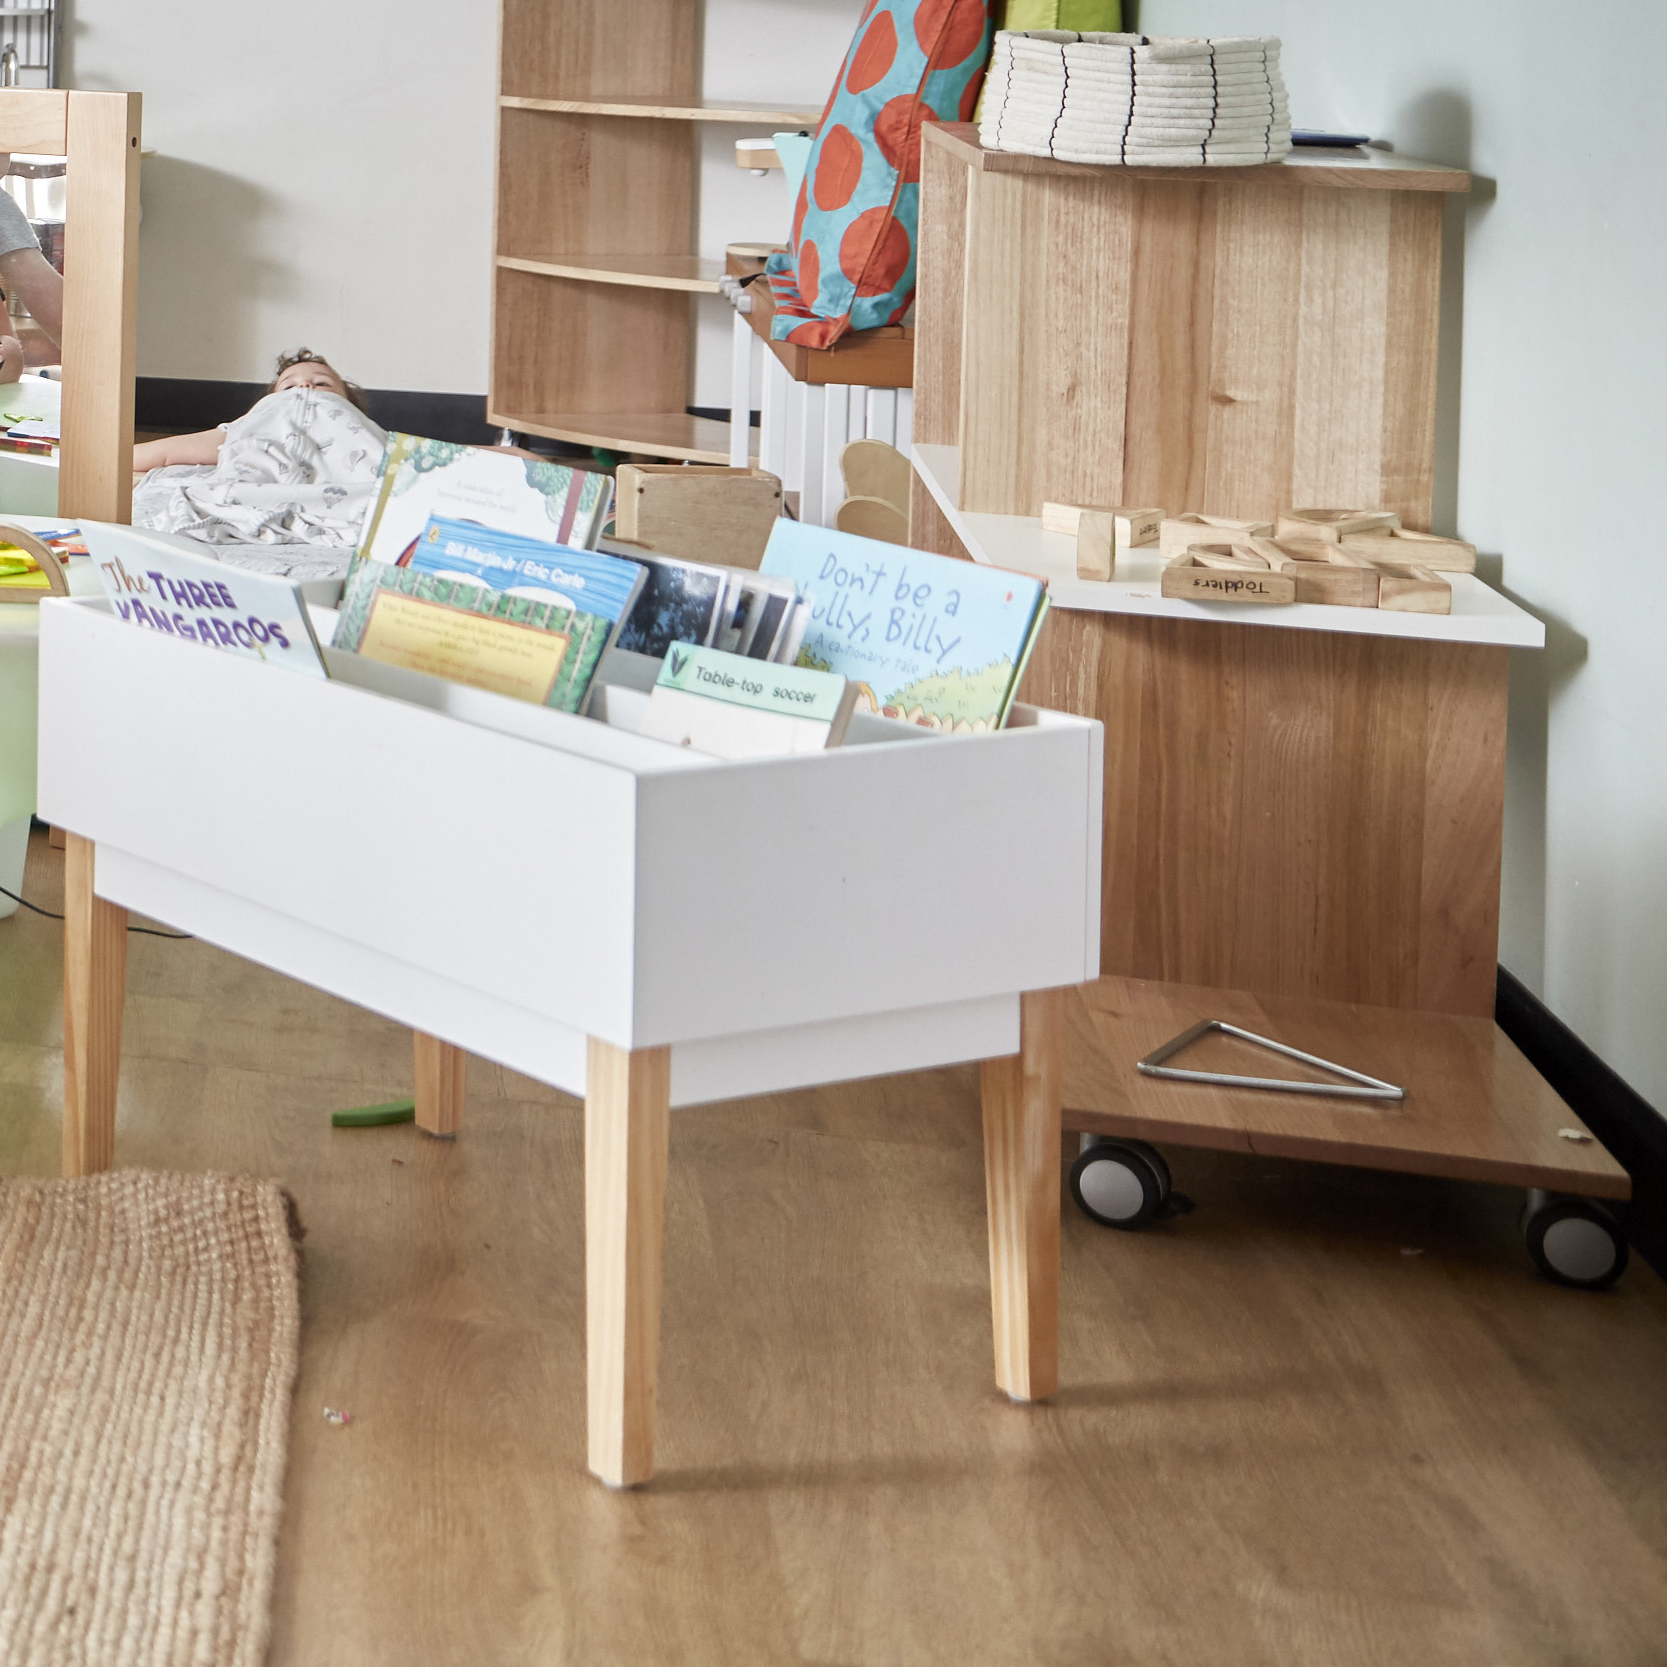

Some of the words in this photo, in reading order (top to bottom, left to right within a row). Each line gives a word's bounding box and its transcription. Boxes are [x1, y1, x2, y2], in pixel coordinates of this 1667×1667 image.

[101, 555, 151, 595] The
[146, 570, 237, 610] THREE
[818, 552, 887, 596] Don't
[894, 565, 932, 608] be
[944, 589, 961, 617] a
[1192, 577, 1270, 596] Toddlers
[802, 581, 872, 642] ully,
[885, 607, 962, 665] Billy
[814, 632, 824, 648] A
[828, 640, 890, 668] cautionary
[894, 658, 920, 675] tale
[696, 666, 764, 695] Table-top
[772, 686, 817, 703] soccer
